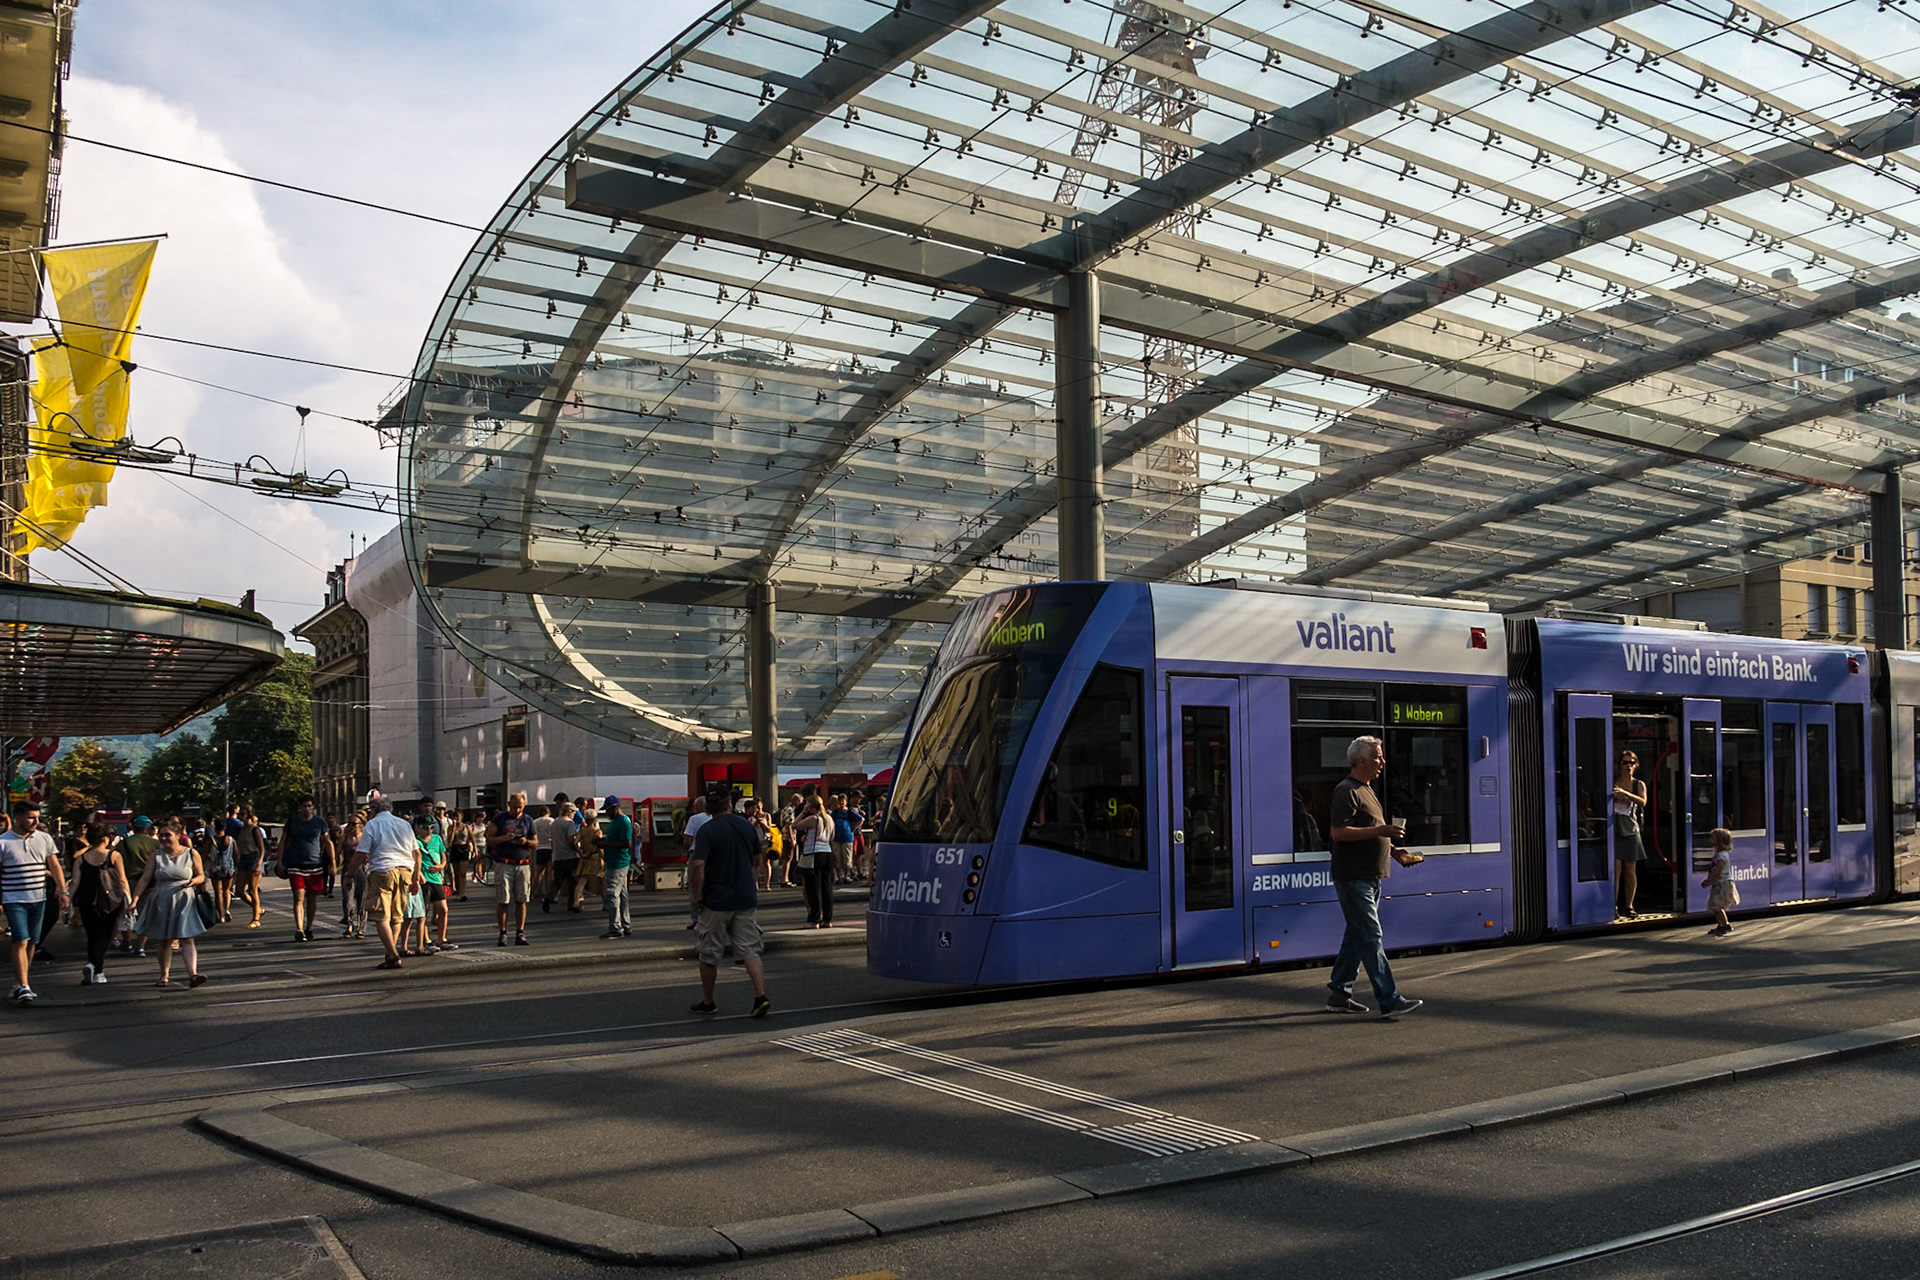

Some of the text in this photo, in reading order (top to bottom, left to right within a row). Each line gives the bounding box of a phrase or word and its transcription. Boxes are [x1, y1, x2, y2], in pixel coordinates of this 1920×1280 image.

[1296, 612, 1396, 653] valiant
[1622, 643, 1817, 682] Wir sind einfach Bank.
[1393, 704, 1443, 721] 9 Wabern
[1107, 797, 1118, 817] 9
[935, 848, 964, 865] 651
[1731, 863, 1769, 881] liant.ch
[881, 872, 943, 904] valiant
